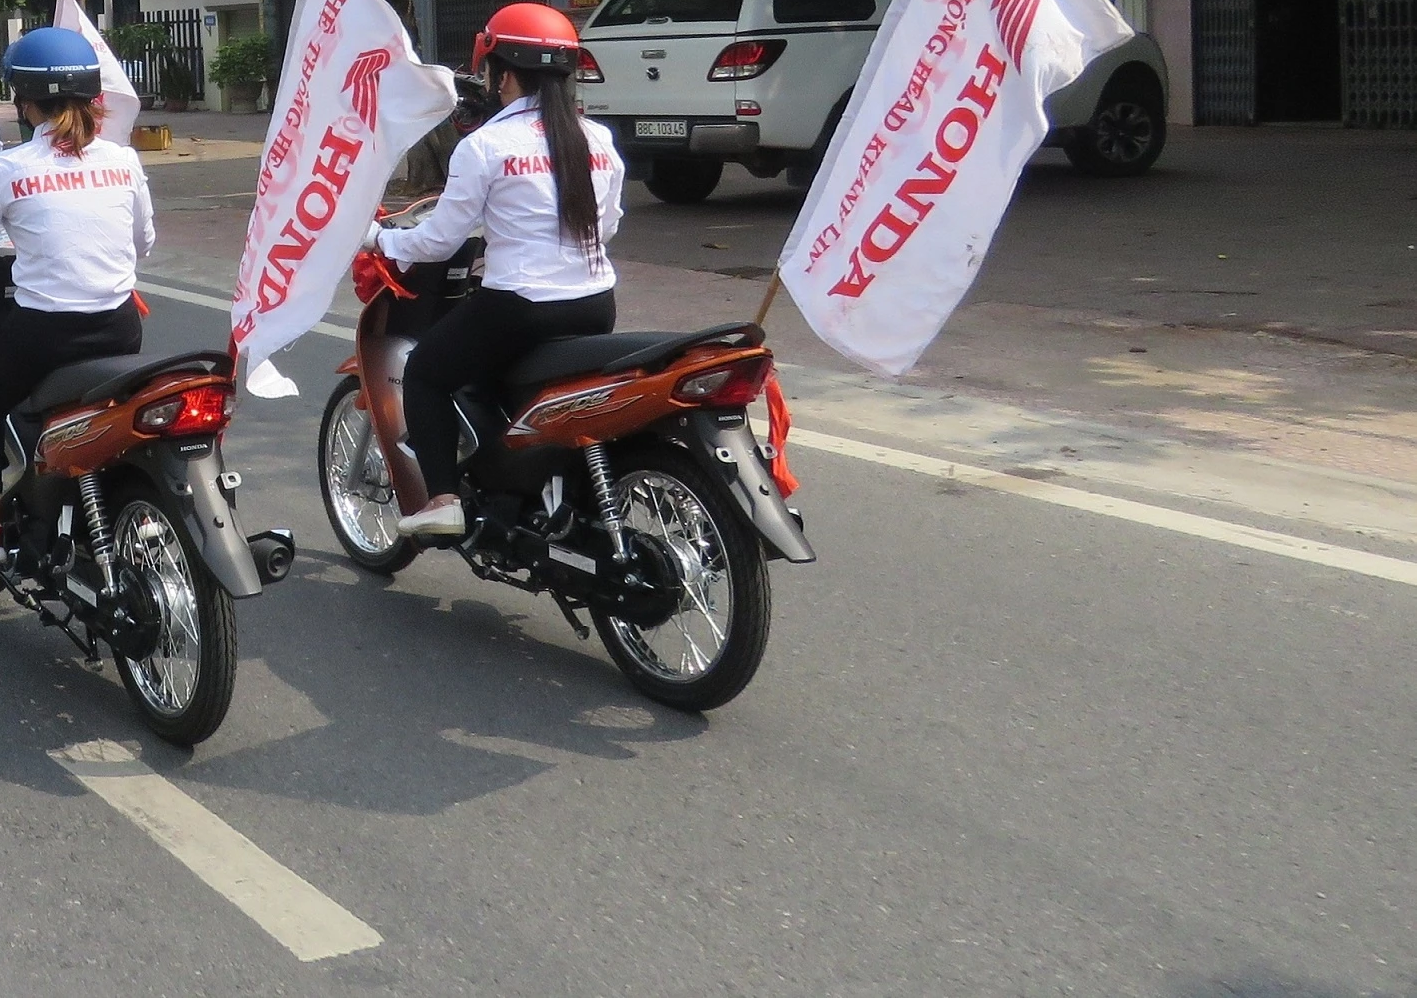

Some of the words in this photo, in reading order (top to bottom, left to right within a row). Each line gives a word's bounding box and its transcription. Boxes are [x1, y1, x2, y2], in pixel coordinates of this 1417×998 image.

[285, 40, 321, 130] THỐNG
[884, 58, 932, 131] HEAD
[11, 169, 88, 199] KHÁNH
[91, 168, 131, 189] LINH
[259, 128, 293, 196] HEAD
[503, 150, 553, 177] KHÁN
[589, 153, 613, 172] NH
[827, 43, 1007, 298] HONDA
[234, 126, 363, 344] HONDA
[804, 223, 841, 274] LIN
[180, 443, 208, 452] HONDA
